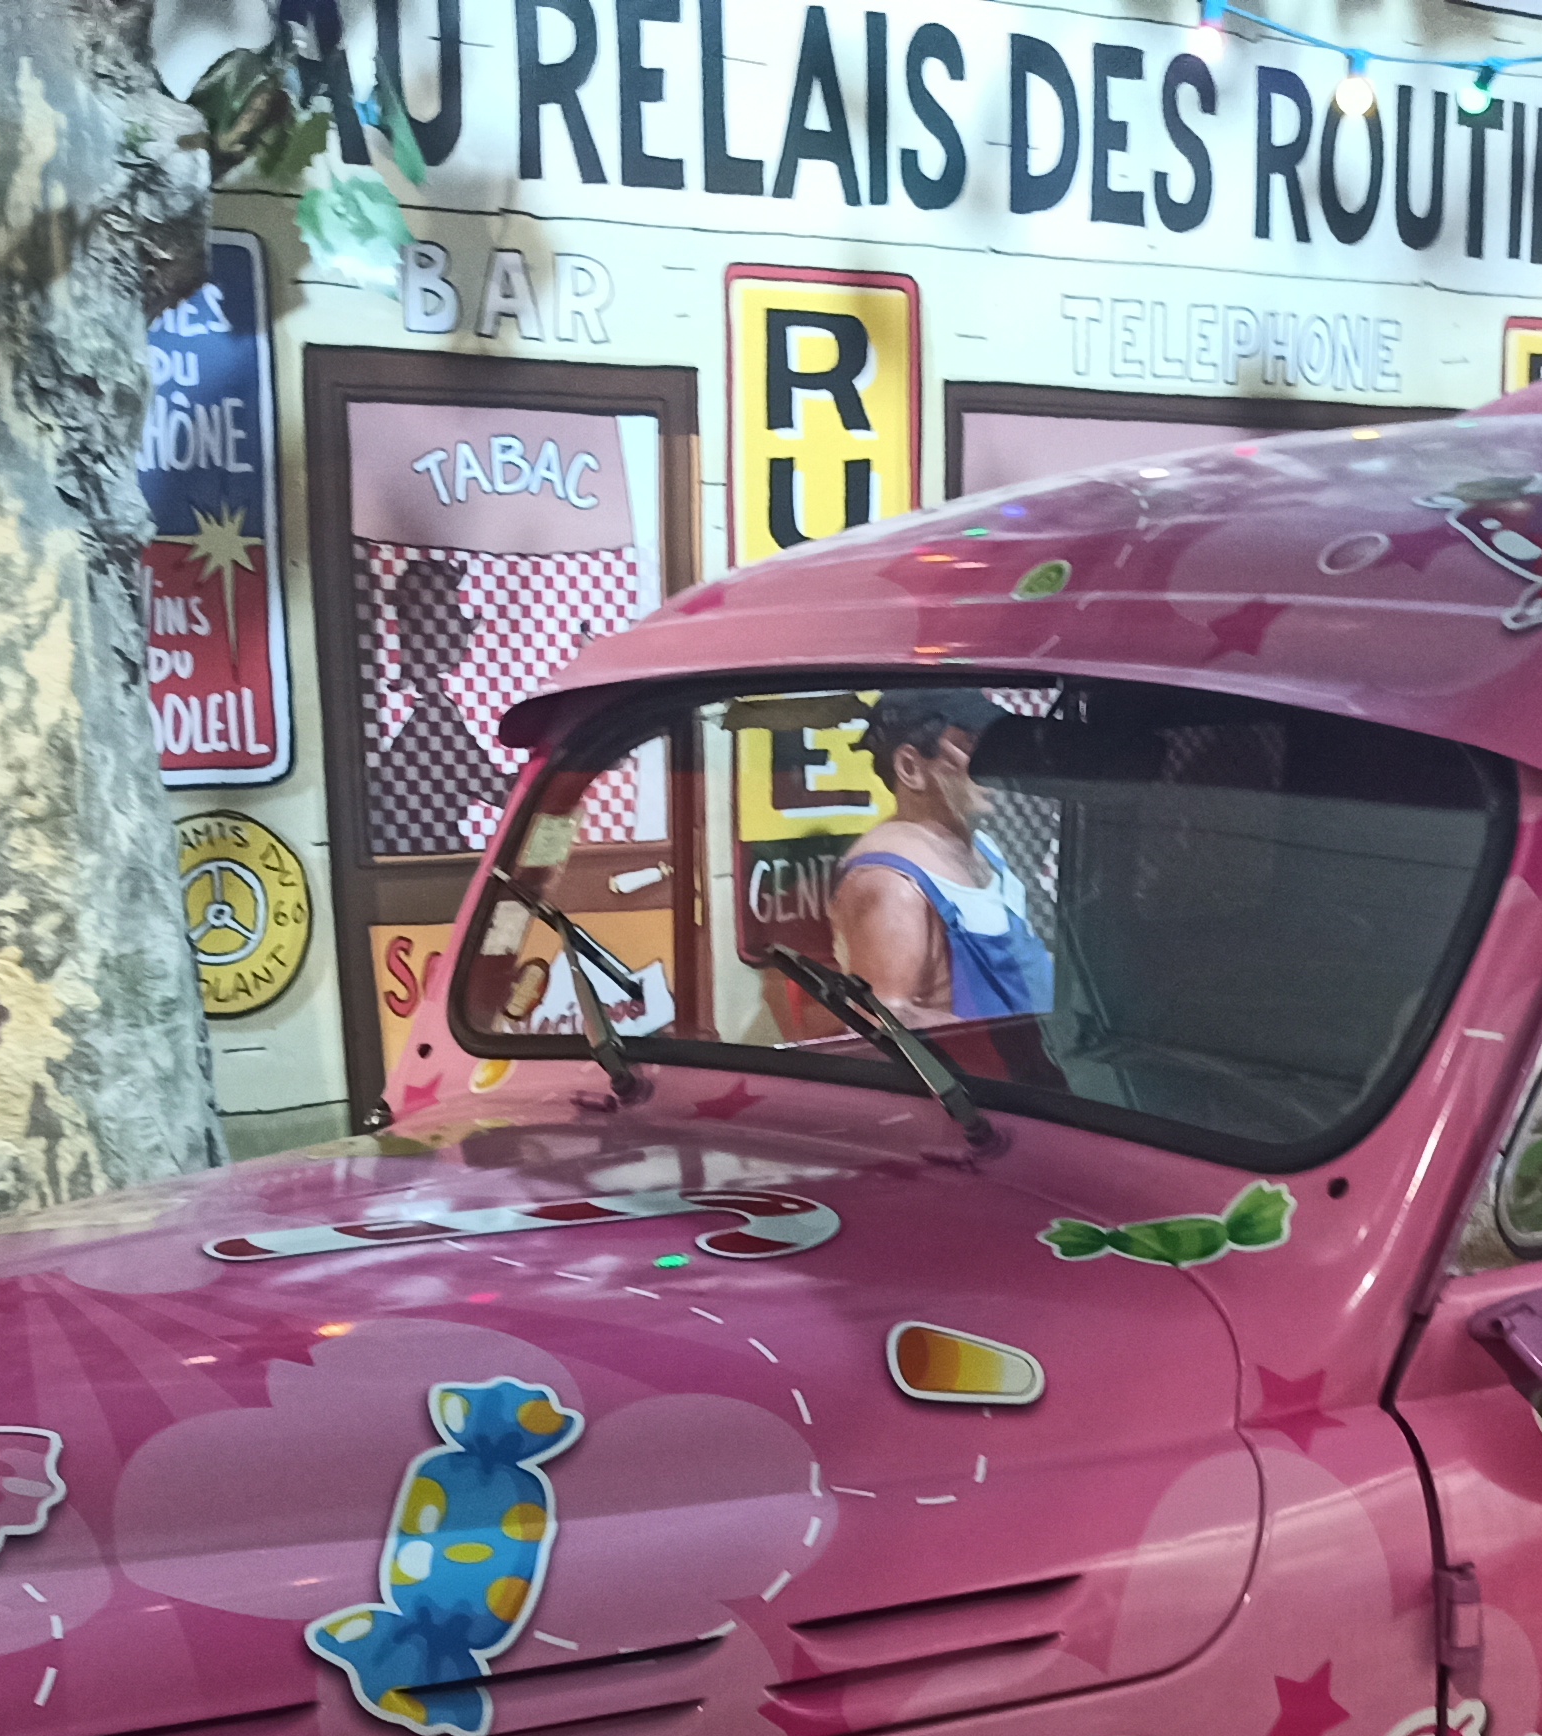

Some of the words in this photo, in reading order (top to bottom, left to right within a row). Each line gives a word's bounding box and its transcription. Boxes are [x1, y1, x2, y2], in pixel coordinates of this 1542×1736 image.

[513, 0, 967, 210] RELAIS
[1009, 34, 1218, 232] DES
[401, 240, 614, 345] BAR
[1061, 293, 1404, 394] TELEPHONE
[135, 390, 254, 473] HÔNE
[413, 434, 601, 511] TABAC
[147, 646, 195, 684] DU
